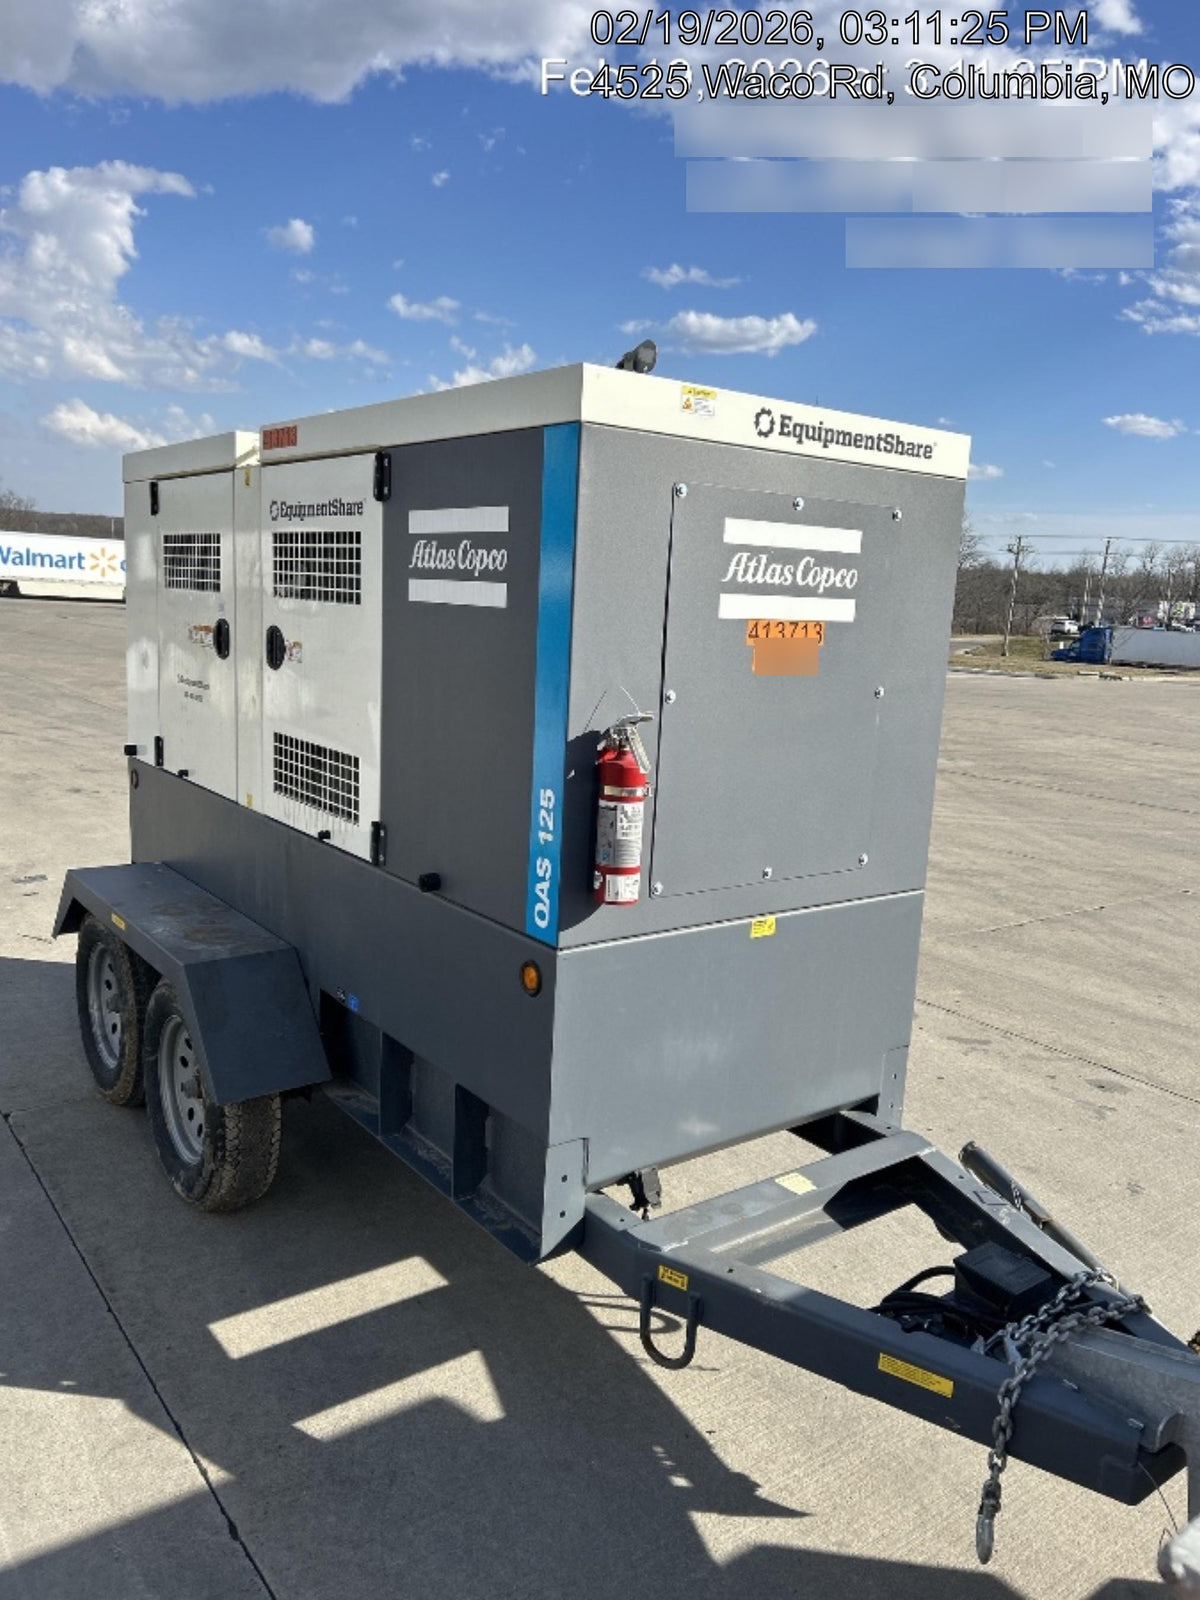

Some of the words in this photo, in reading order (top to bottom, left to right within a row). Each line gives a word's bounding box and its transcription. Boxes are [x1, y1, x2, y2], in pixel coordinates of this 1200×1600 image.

[778, 414, 934, 460] EquipmentShare
[280, 498, 364, 521] EquipmentShare
[408, 539, 456, 570] Atlas
[457, 539, 508, 577] Copco
[721, 552, 794, 586] Atlas
[796, 556, 858, 594] Copco
[538, 788, 556, 845] 125
[534, 857, 552, 929] OAS
